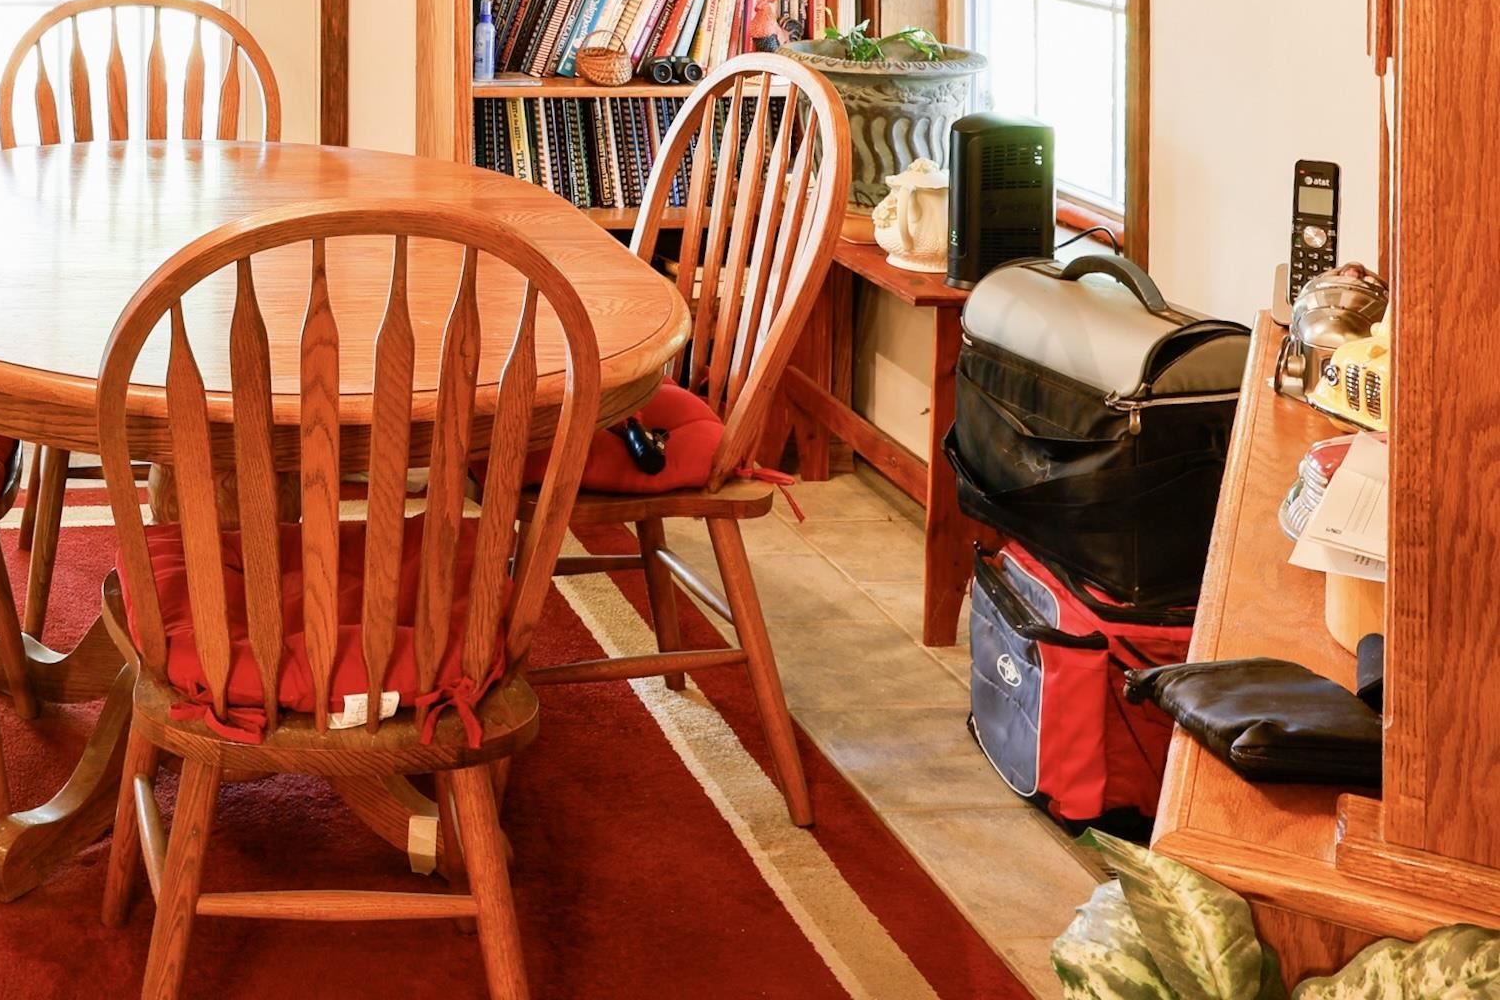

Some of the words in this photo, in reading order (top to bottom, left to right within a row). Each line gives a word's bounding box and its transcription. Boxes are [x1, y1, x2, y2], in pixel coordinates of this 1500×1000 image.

[551, 14, 576, 62] OKLAHOMA
[515, 149, 529, 180] TEXA
[600, 172, 611, 199] TEXAS
